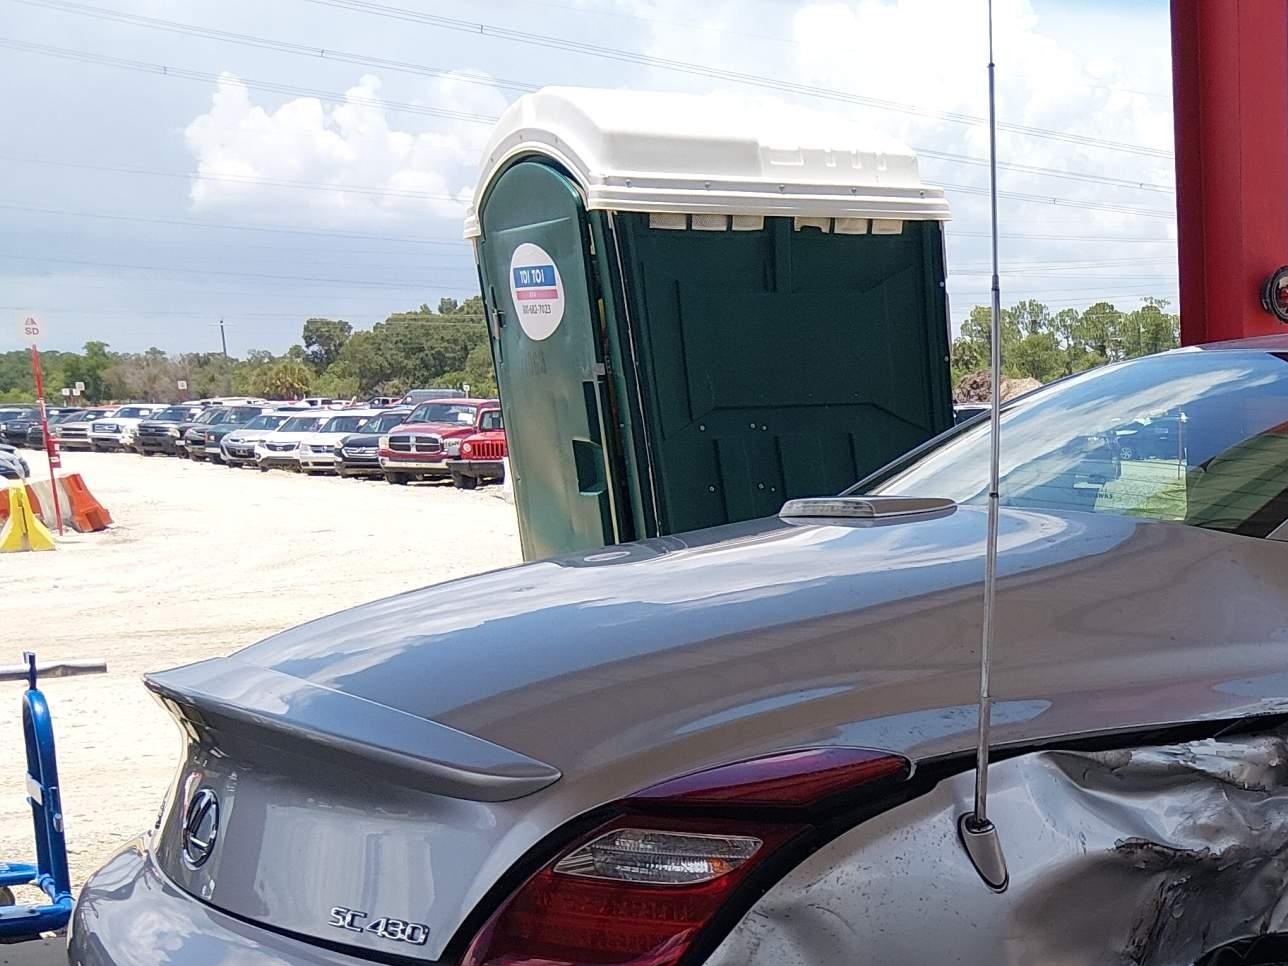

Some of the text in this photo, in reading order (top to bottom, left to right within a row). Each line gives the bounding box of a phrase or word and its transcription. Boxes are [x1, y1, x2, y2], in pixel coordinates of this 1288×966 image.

[520, 269, 544, 284] TOI TOI
[25, 327, 39, 335] SD
[328, 906, 431, 945] SC 430
